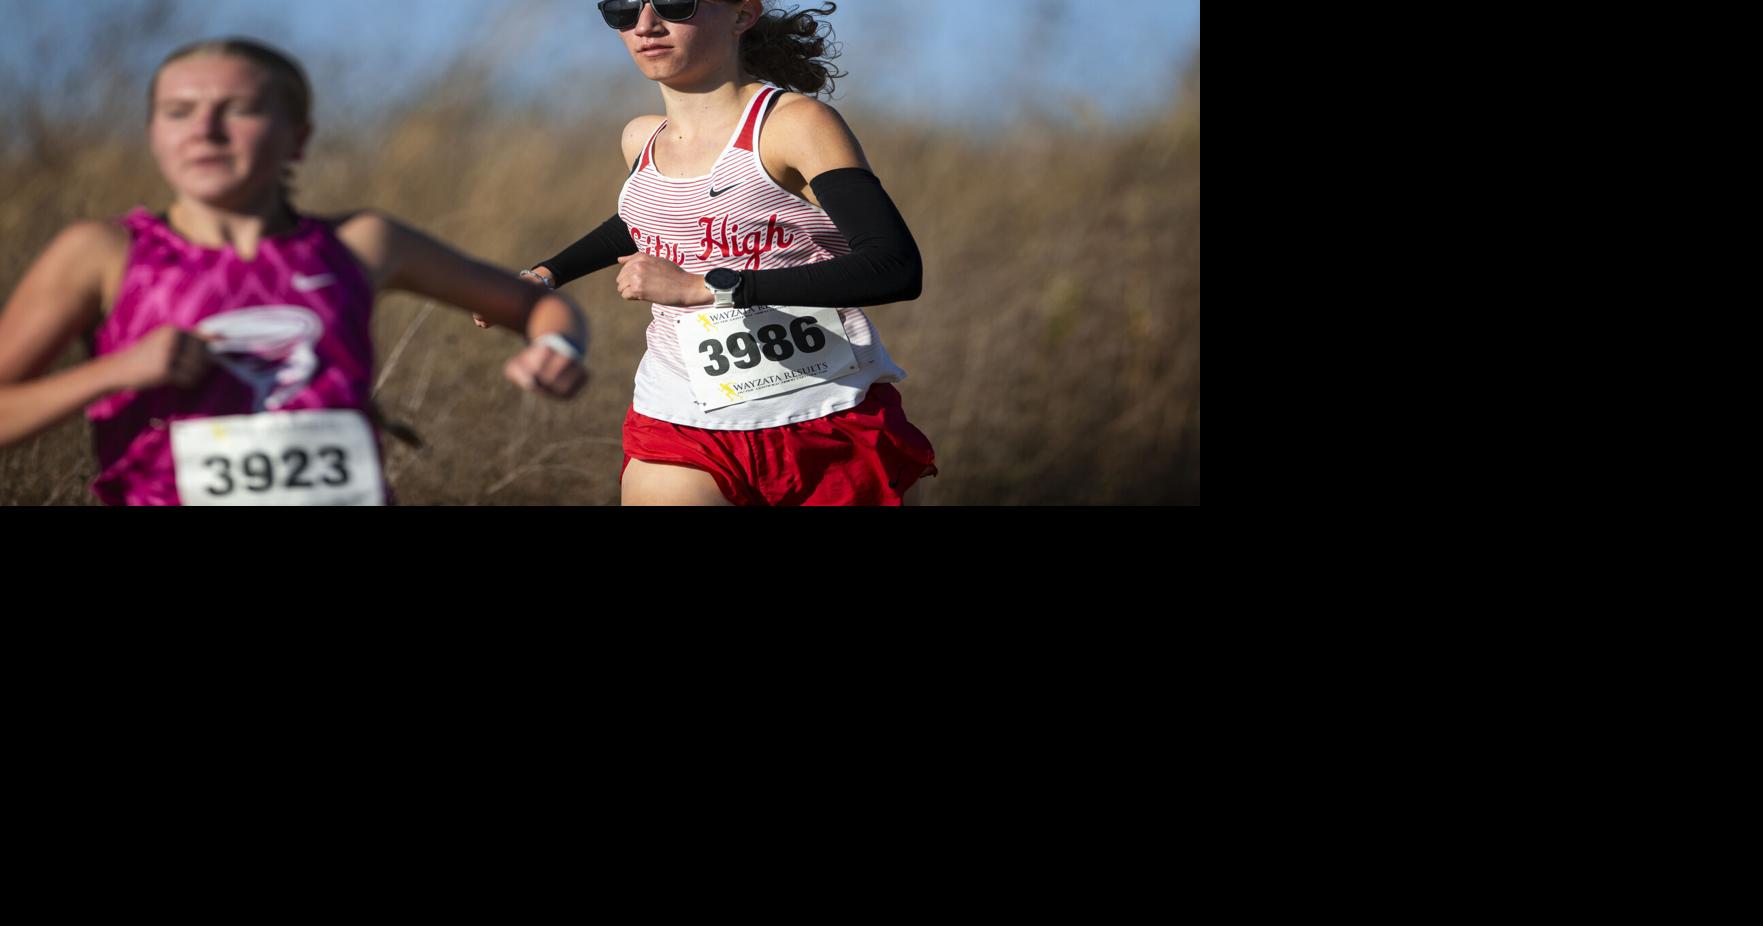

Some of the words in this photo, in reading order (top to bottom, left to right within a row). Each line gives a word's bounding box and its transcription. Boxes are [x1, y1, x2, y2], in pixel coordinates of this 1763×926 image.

[695, 213, 794, 270] High
[698, 315, 826, 377] 3986
[733, 374, 782, 391] WAYZATA
[784, 361, 829, 379] RESULTS
[203, 446, 350, 495] 3923
